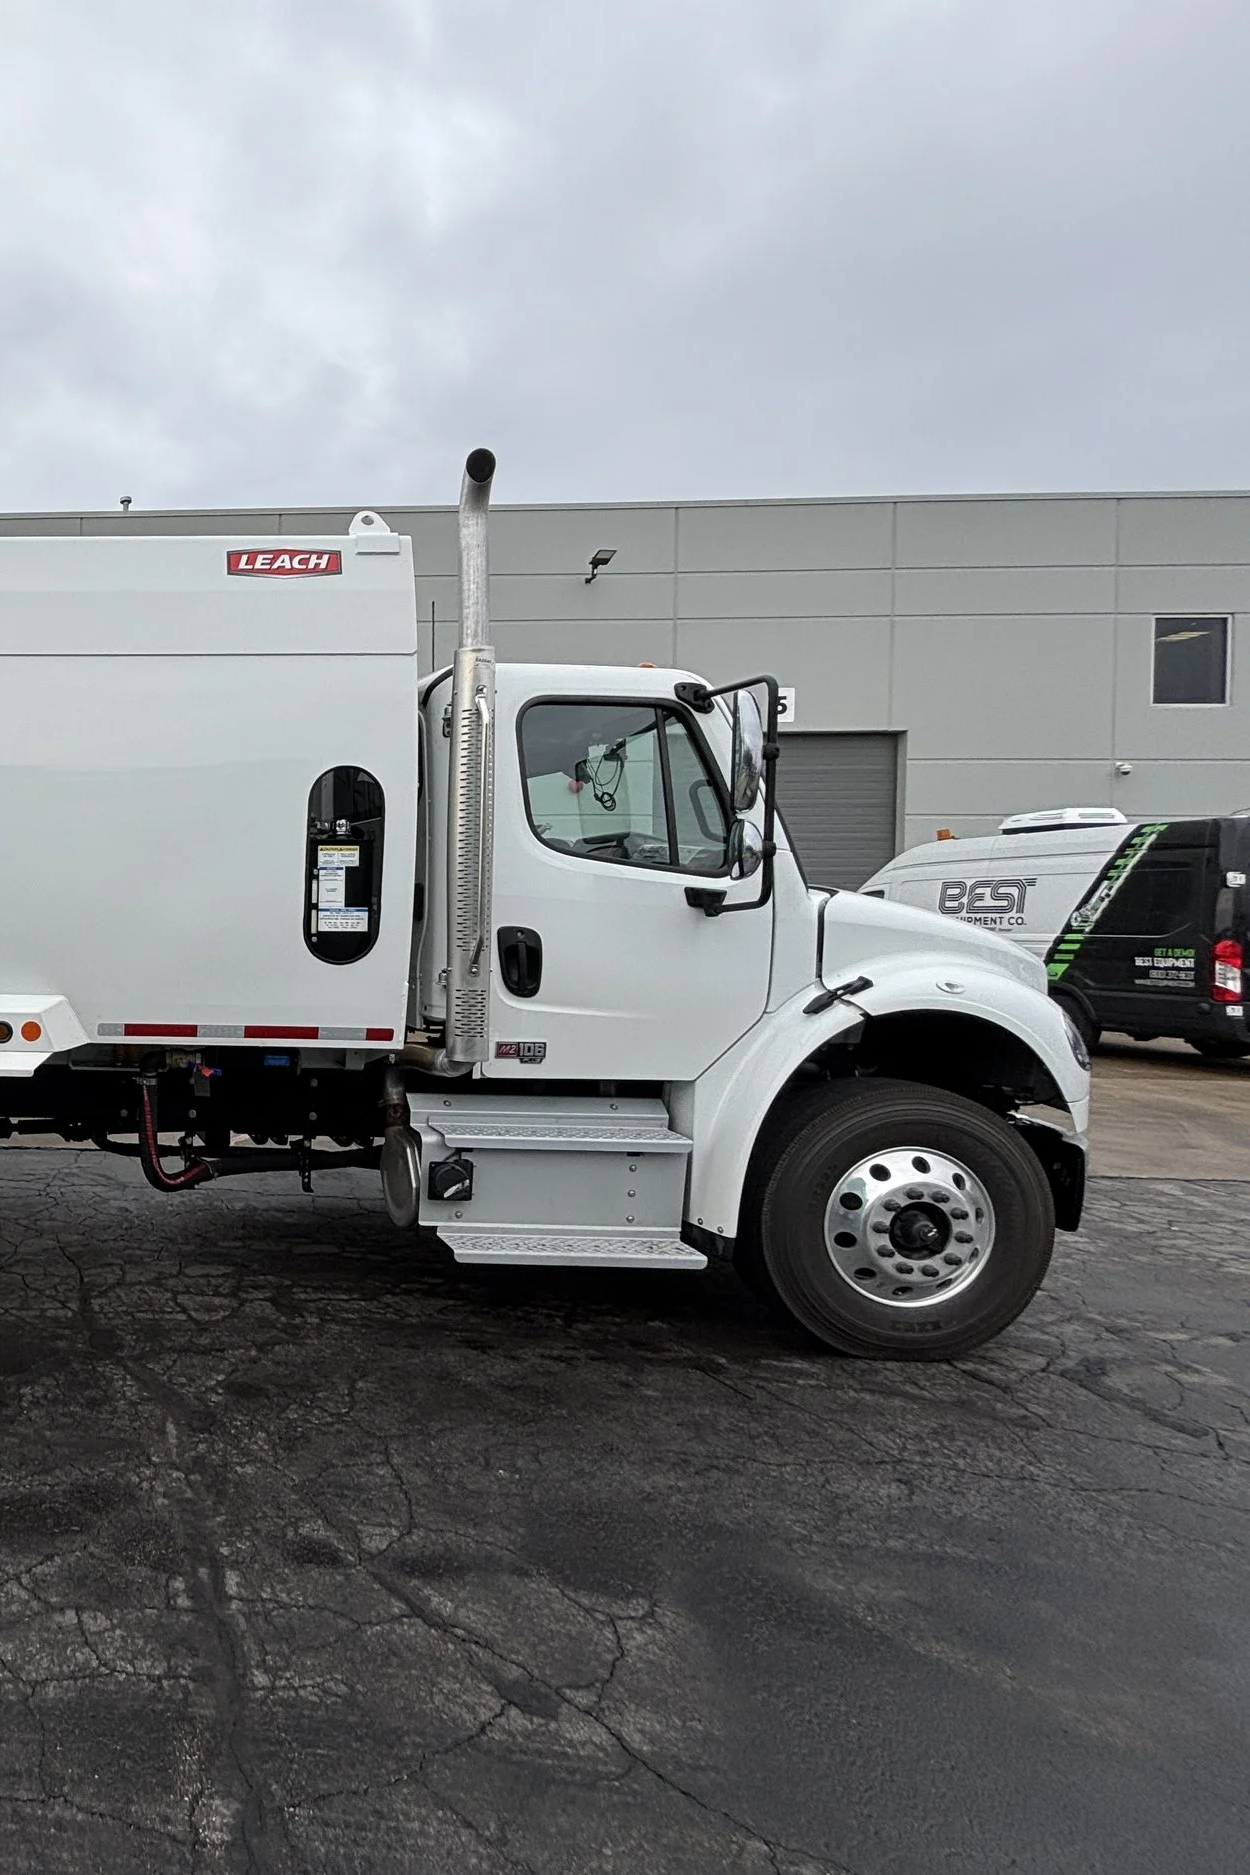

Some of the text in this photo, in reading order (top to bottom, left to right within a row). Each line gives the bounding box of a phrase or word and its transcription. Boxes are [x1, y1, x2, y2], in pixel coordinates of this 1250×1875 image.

[238, 554, 330, 569] LEACH
[938, 878, 1038, 915] BEST
[519, 1043, 545, 1057] 106
